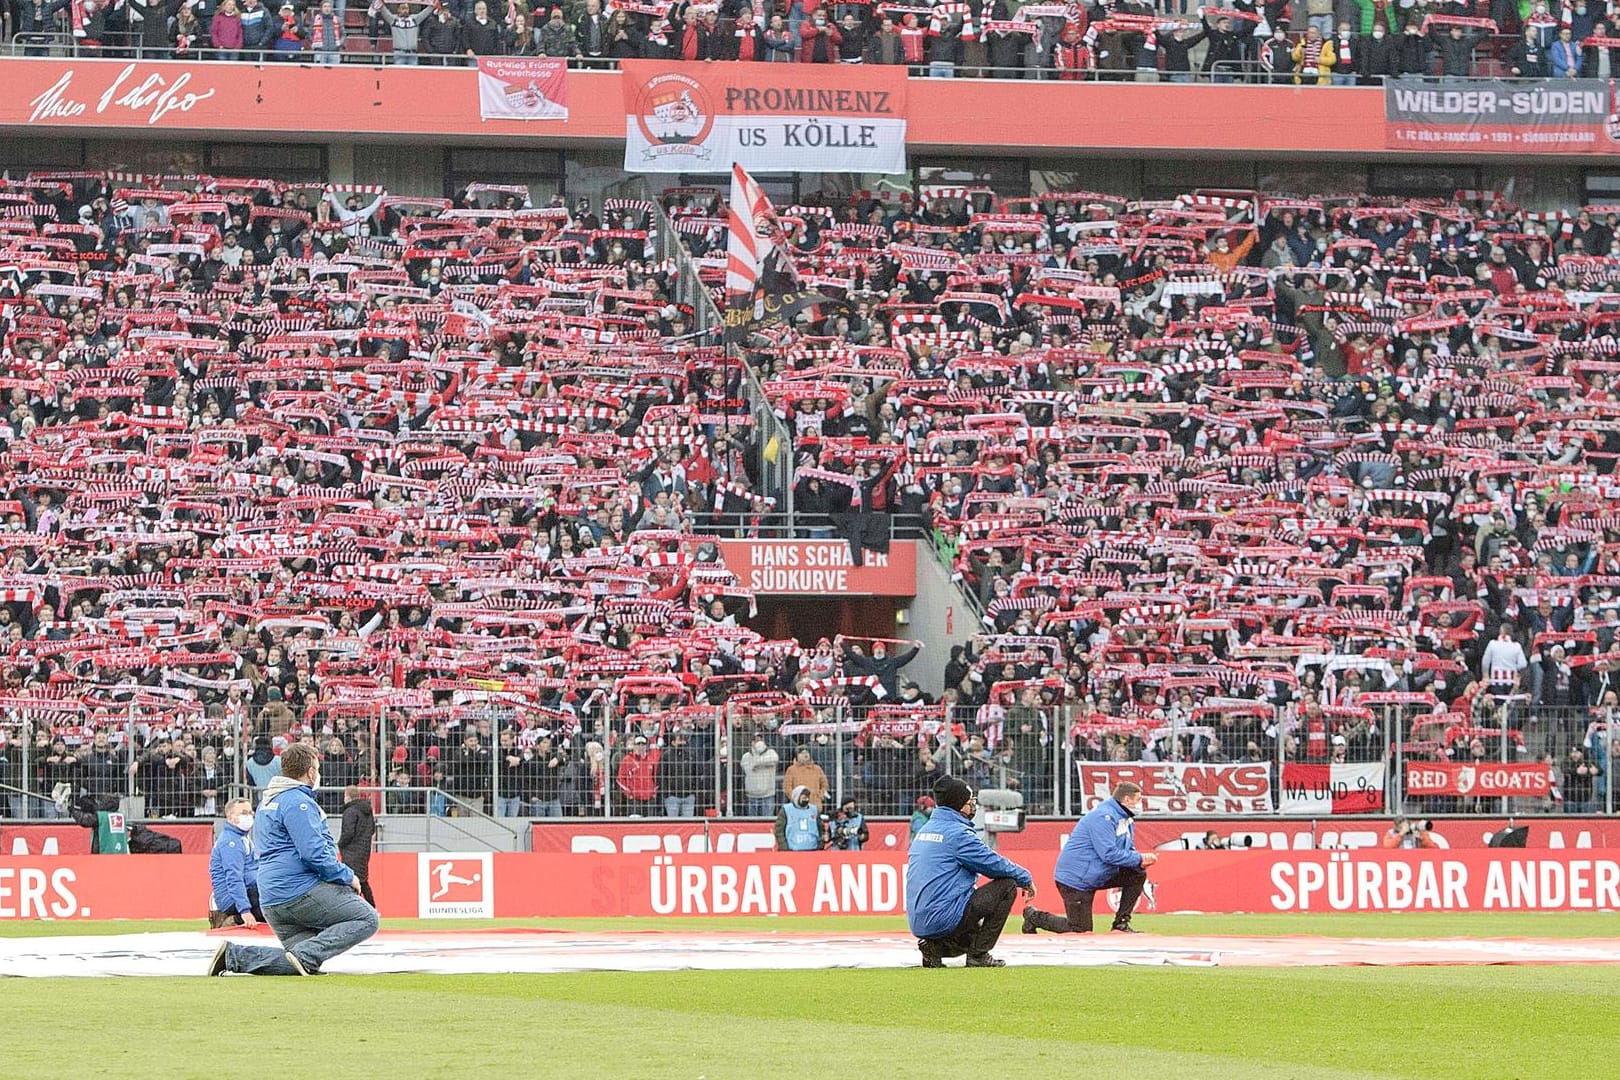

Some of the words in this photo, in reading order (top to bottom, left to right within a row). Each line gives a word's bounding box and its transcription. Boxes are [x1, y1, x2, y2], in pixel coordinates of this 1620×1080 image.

[725, 87, 893, 114] PROMINENZ
[1394, 86, 1605, 116] WILDER-SÜDEN
[783, 118, 878, 149] KÖLLE
[751, 546, 799, 567] HANS
[806, 541, 889, 567] SCHÄER
[750, 566, 848, 592] SÜDKURVE
[1081, 765, 1269, 798] FREAKS
[1286, 780, 1308, 801] NA
[1313, 780, 1348, 801] UND
[1357, 776, 1378, 804] 98
[1408, 770, 1448, 789] RED
[1480, 769, 1547, 790] GOATS
[1086, 797, 1269, 813] CLOGNE
[1270, 852, 1470, 910] SPÜRBAR
[429, 906, 484, 915] BUNDESLIGA
